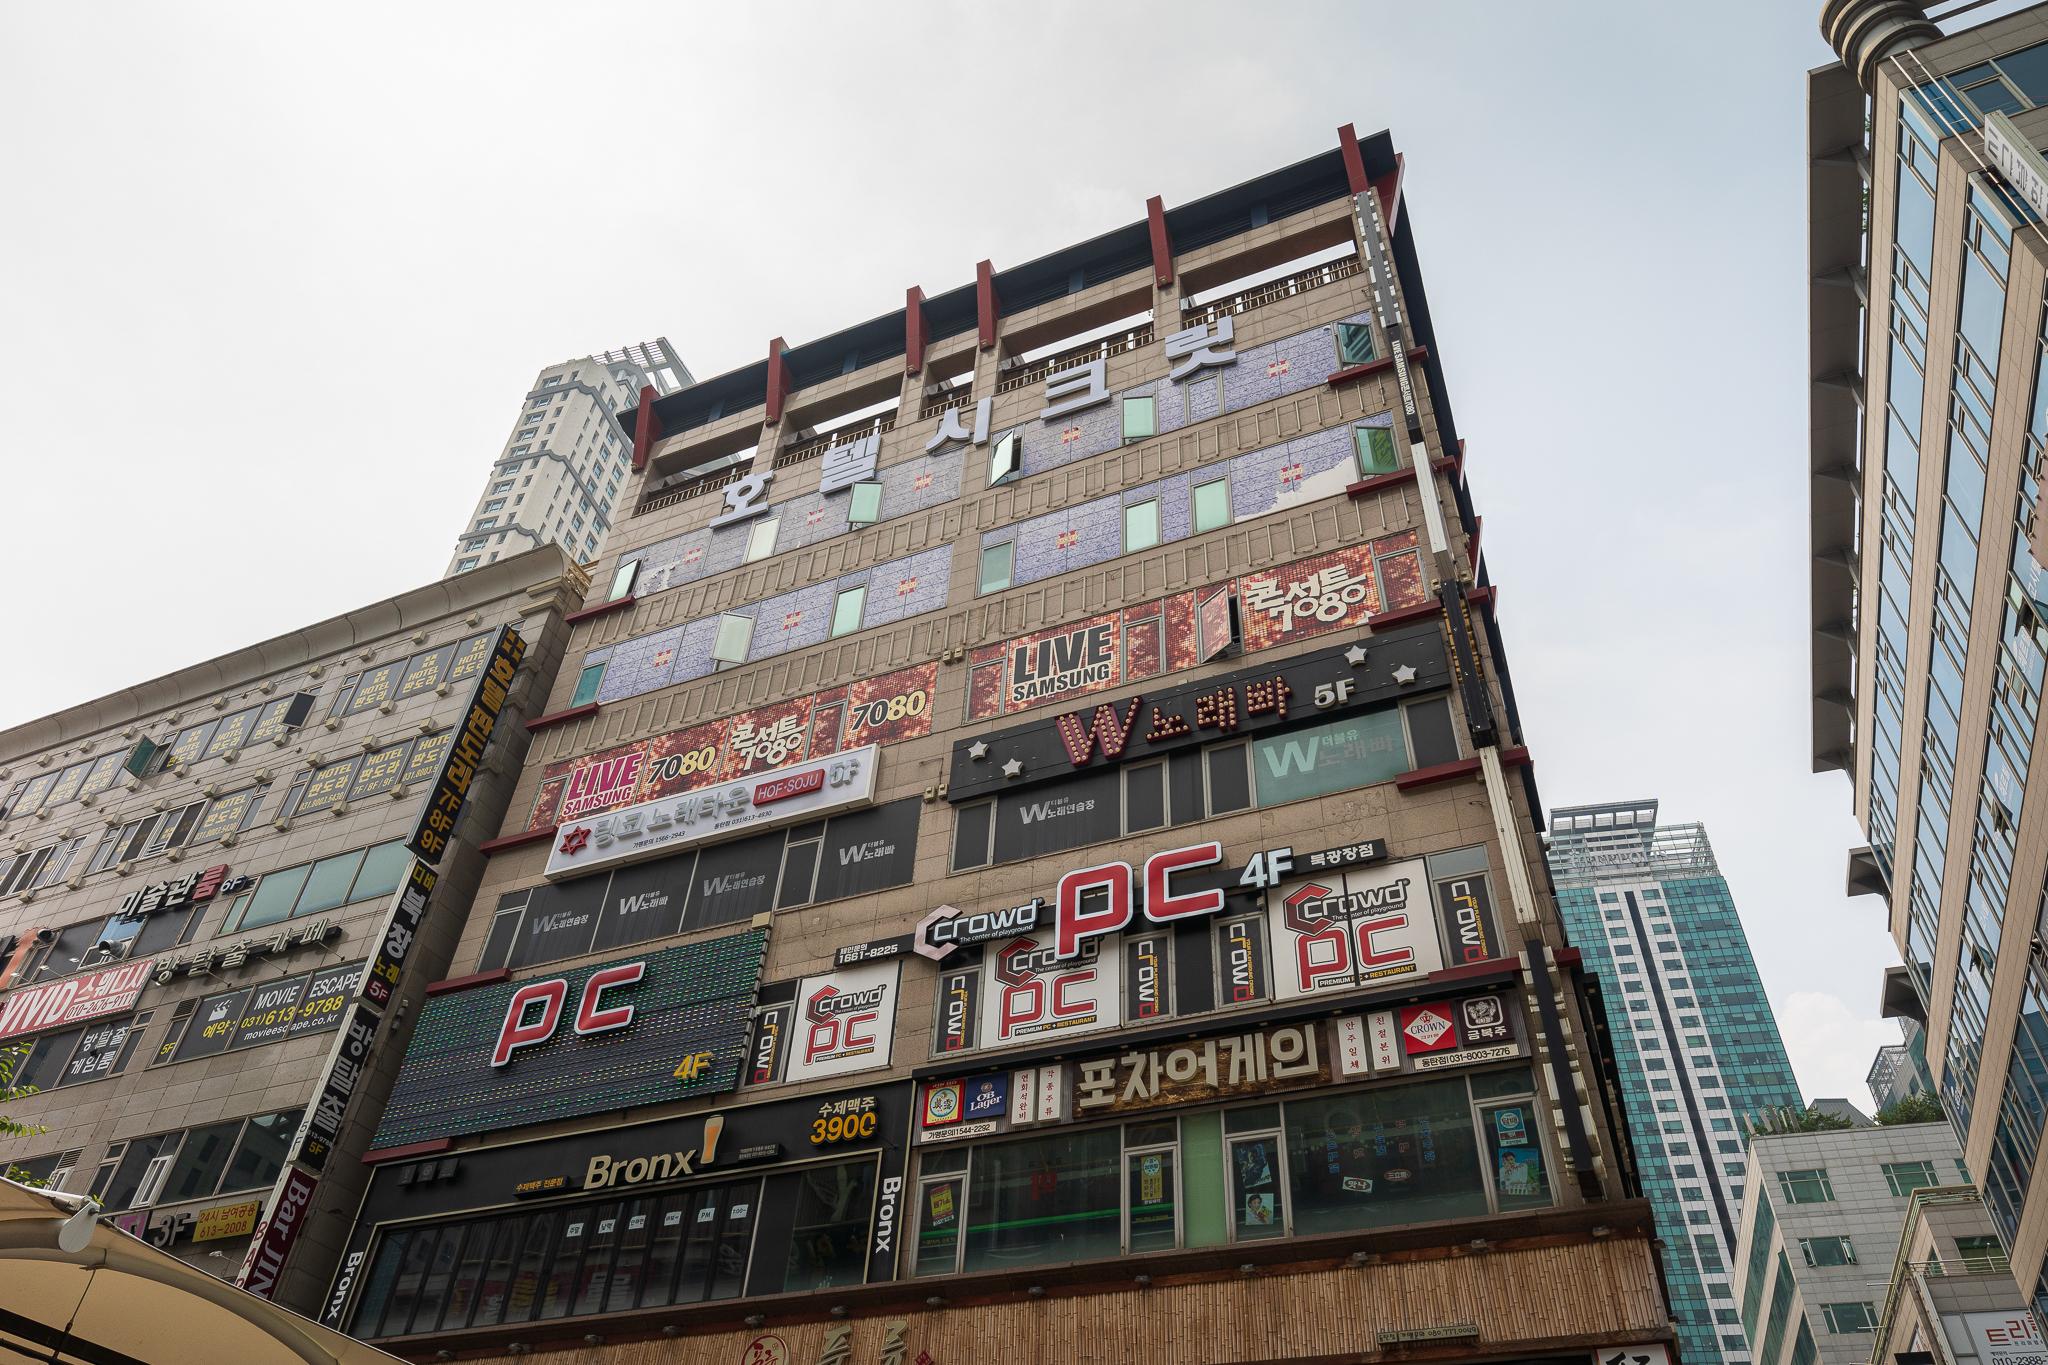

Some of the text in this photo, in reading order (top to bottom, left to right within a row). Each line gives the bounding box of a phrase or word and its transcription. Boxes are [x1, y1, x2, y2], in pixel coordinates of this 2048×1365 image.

[1246, 563, 1367, 612] 콘서트
[1269, 583, 1367, 633] 7080
[458, 652, 486, 666] HOTE
[1012, 622, 1116, 687] LIVE
[402, 676, 437, 693] 판도라
[408, 666, 439, 681] HOTEL
[1011, 660, 1112, 704] SAMSUNG
[353, 690, 388, 709] 판도라
[360, 682, 390, 697] HOTEL
[1314, 676, 1356, 710] 5F
[850, 689, 928, 733] 7080
[1055, 674, 1293, 768] W 노래빠
[217, 728, 244, 742] HOTEL
[447, 654, 517, 796] 호텔 판도라
[731, 714, 808, 752] 콘서트
[1321, 728, 1360, 747] 더블유
[420, 733, 451, 750] HOTE
[740, 732, 803, 771] 7080
[358, 757, 401, 783] 판도라
[367, 748, 403, 765] HOTEL
[648, 746, 716, 786] 7080
[1262, 735, 1321, 779] W
[317, 763, 353, 780] HOTEL
[566, 751, 645, 802] LIVE
[308, 774, 349, 798] 판도라
[437, 787, 461, 812] 7F
[213, 794, 247, 811] HOTEL
[562, 785, 634, 816] SAMSUNG
[1019, 801, 1053, 827] W
[204, 805, 242, 827] 판도라
[429, 808, 454, 833] 8F
[420, 829, 445, 854] 9F
[839, 842, 868, 866] W
[1310, 842, 1375, 868] 북광장점
[412, 864, 437, 892] 디바
[1239, 848, 1294, 890] 4F
[220, 874, 244, 893] 6F
[703, 875, 730, 897] W
[619, 892, 646, 916] W
[1054, 840, 1226, 963] PC
[1303, 879, 1405, 920] crowd
[1370, 901, 1405, 916] playground
[532, 913, 559, 935] W
[934, 898, 1039, 941] crowd
[971, 933, 991, 942] center
[991, 930, 999, 938] of
[998, 924, 1033, 939] playground
[1451, 880, 1488, 963] crowd
[839, 943, 899, 964] 1661-8225
[1230, 922, 1251, 1002] crowd
[1294, 913, 1416, 993] PC
[78, 959, 154, 1000] 스웨디시
[373, 955, 400, 985] 노래
[1138, 940, 1156, 1019] crowd
[1319, 964, 1416, 988] PREMIUM RESTAURANT
[254, 971, 362, 1011] MOVIE ESCAPE
[367, 981, 388, 1000] 5F
[819, 984, 882, 1013] crowd
[998, 968, 1098, 1040] PC
[0, 981, 79, 1034] VIVID
[490, 960, 647, 1069] PC
[946, 975, 966, 1051] crowd
[803, 1009, 880, 1067] PC
[1015, 1024, 1043, 1036] PREMIUM
[1056, 1015, 1097, 1029] RESTAURANT
[1410, 1020, 1446, 1036] CROWN
[1467, 1026, 1507, 1041] 금복주
[160, 1042, 176, 1056] 5F
[753, 1010, 778, 1084] crowd
[1345, 1021, 1361, 1069] 안주일체
[1421, 1046, 1511, 1069] 동탄점 031-8003-7276
[71, 1050, 118, 1076] 게임룸
[313, 1019, 373, 1134] 방탈출
[672, 1050, 714, 1081] 4F
[1077, 1023, 1320, 1110] 포차어게인
[818, 1095, 876, 1119] 수제맥주
[969, 1095, 1003, 1112] Lager
[976, 1091, 996, 1102] OB
[954, 1123, 992, 1137] 1544-2292
[309, 1142, 323, 1155] 5F
[583, 1149, 697, 1190] Bronx
[199, 1208, 219, 1224] 24시
[875, 1176, 903, 1255] Bronx
[153, 1213, 187, 1249] 3F
[199, 1221, 248, 1239] 613-2008
[247, 1177, 312, 1300] Bar JIN
[325, 1251, 364, 1320] Bronx
